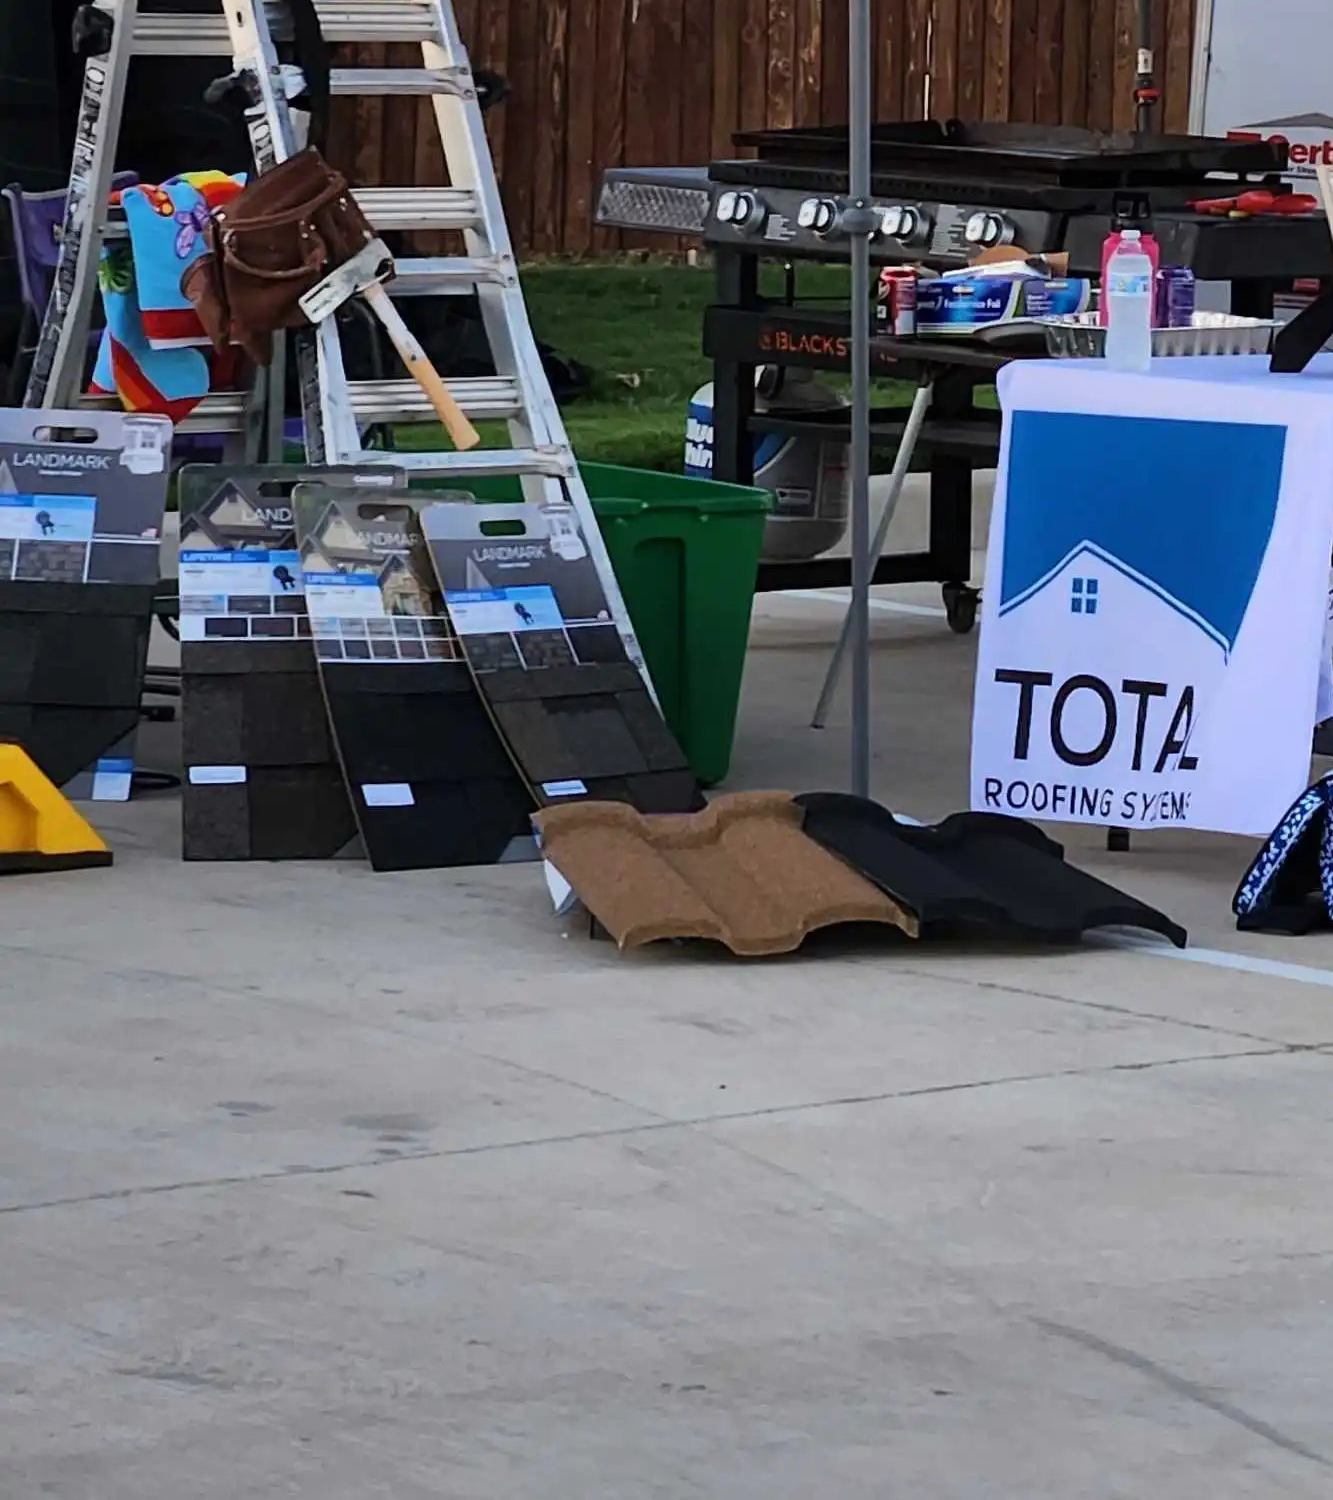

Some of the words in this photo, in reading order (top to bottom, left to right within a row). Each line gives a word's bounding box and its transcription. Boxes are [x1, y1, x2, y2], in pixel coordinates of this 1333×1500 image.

[13, 452, 111, 469] LANDMARK
[241, 507, 292, 522] LAND
[472, 544, 546, 562] LANDMARK
[984, 777, 1114, 818] ROOFING
